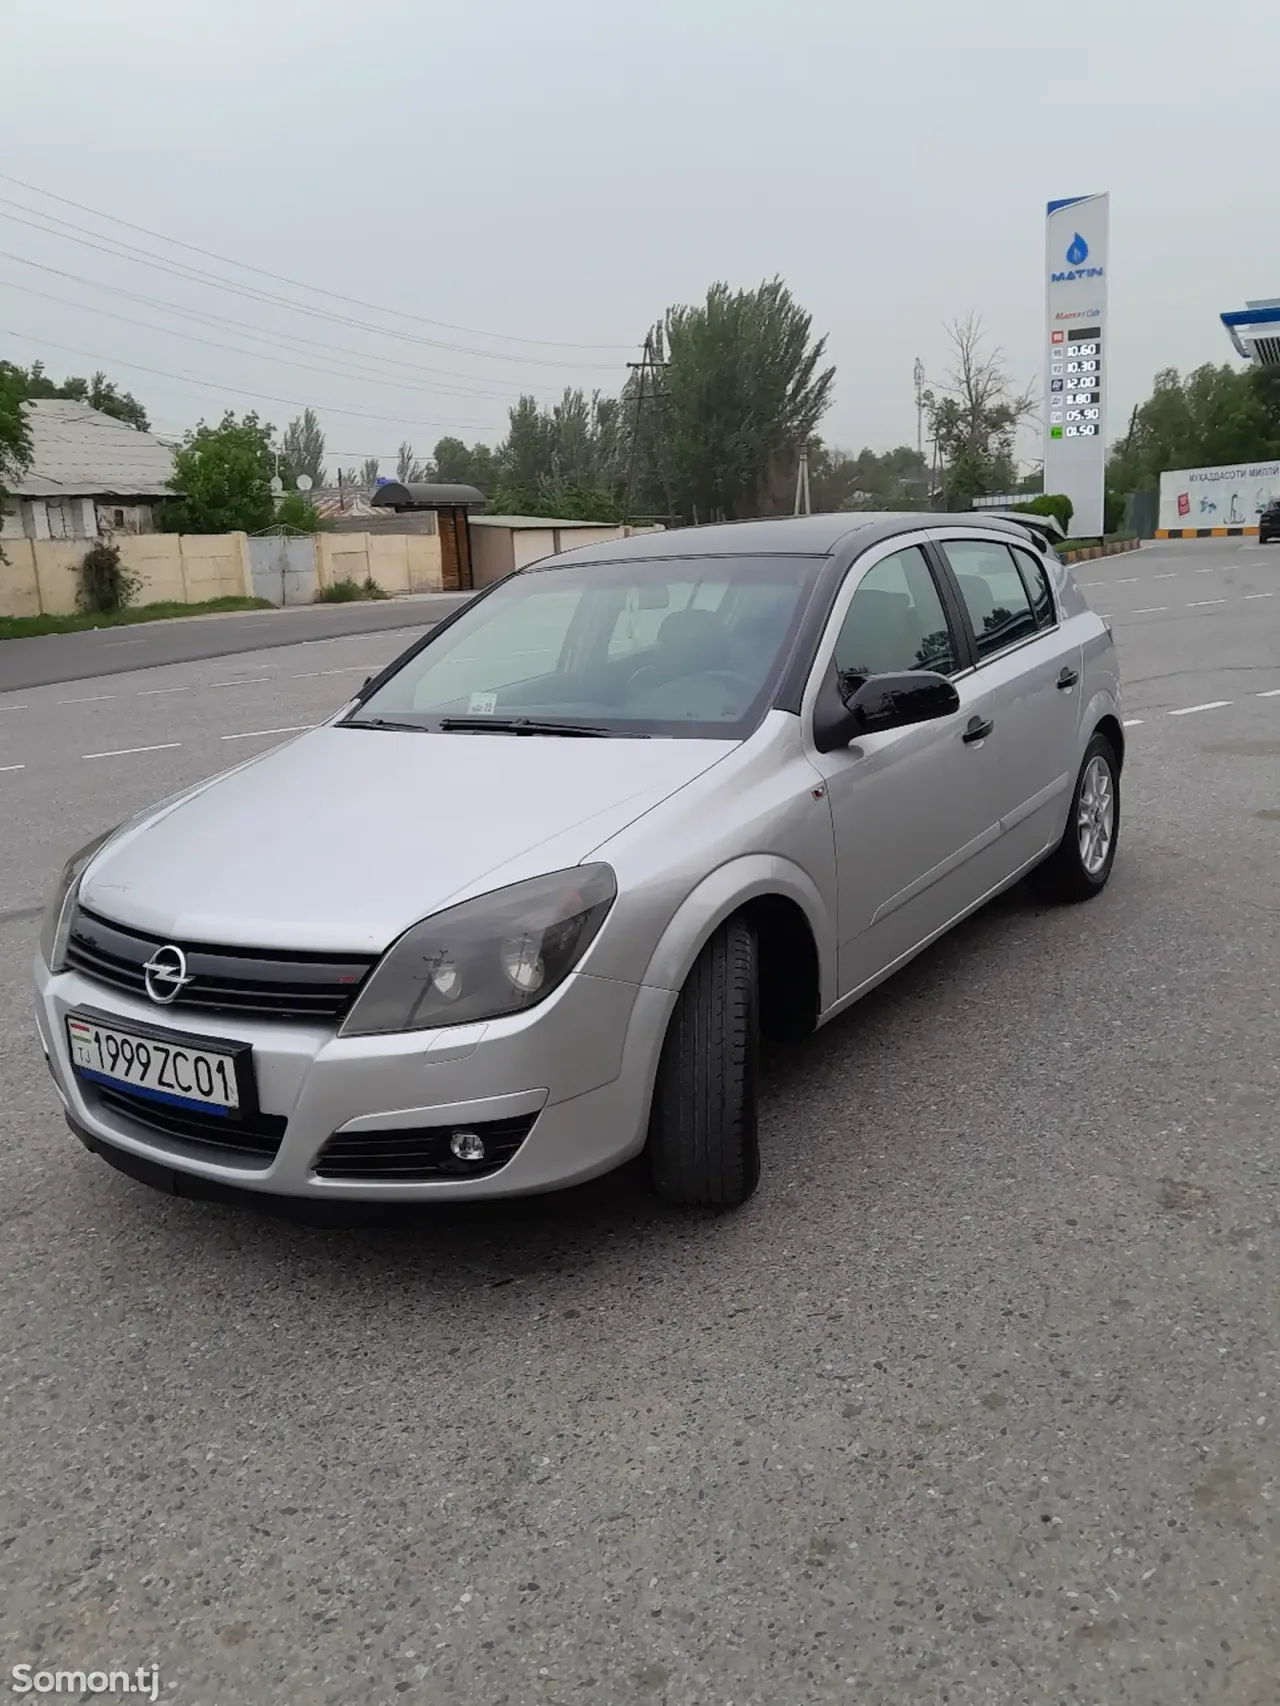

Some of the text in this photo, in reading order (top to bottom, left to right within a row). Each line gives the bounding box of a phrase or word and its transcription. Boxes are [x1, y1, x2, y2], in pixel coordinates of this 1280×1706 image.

[1051, 266, 1103, 283] MATIN
[1067, 343, 1097, 357] 10.60
[1067, 360, 1097, 374] 10.30
[1066, 376, 1096, 389] 12.00
[1066, 408, 1099, 421] 05.90
[1066, 424, 1095, 437] 01.50
[78, 1030, 230, 1102] TJ 1999ZC01
